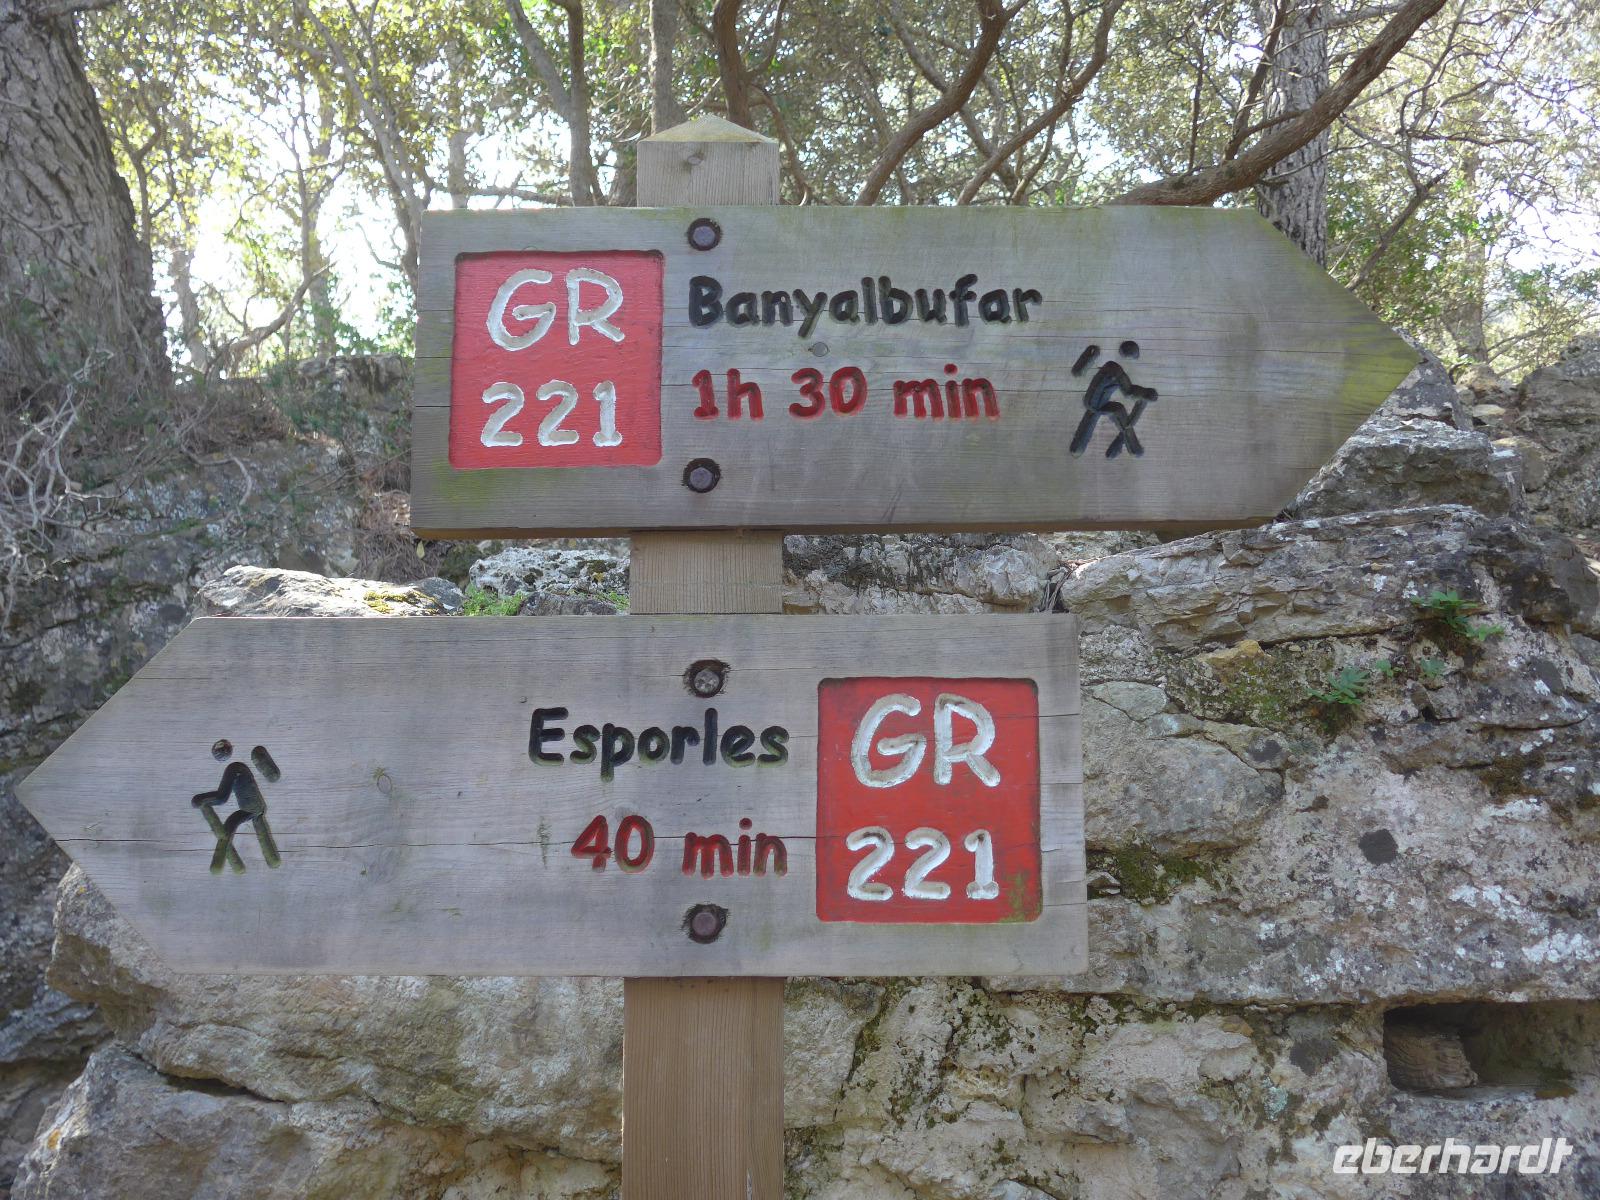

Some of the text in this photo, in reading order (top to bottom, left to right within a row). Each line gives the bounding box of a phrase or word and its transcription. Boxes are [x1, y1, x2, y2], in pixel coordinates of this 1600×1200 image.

[486, 267, 626, 352] GR
[688, 273, 1043, 338] Banyalbufar
[480, 379, 624, 449] 221
[692, 363, 1000, 421] 1h 30 min
[529, 706, 788, 782] Esporles
[850, 692, 1001, 789] GR
[571, 814, 787, 878] 40 min
[845, 826, 1000, 902] 221
